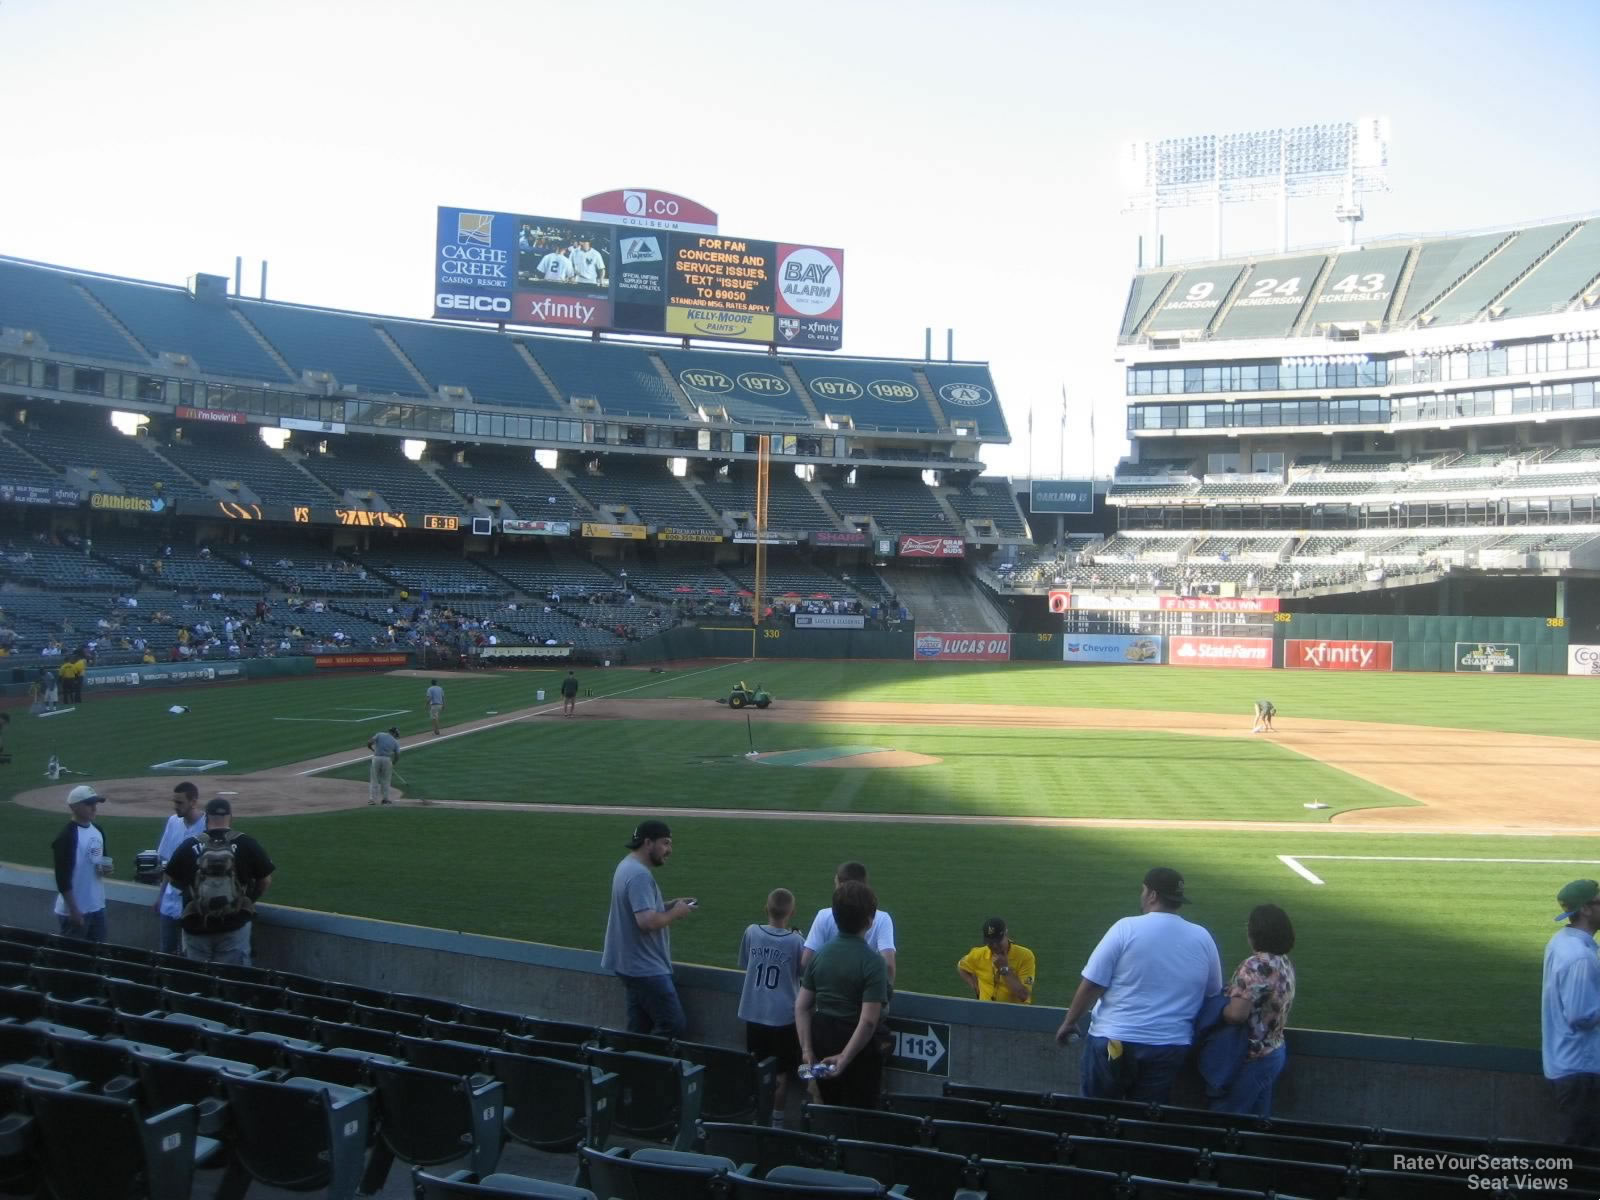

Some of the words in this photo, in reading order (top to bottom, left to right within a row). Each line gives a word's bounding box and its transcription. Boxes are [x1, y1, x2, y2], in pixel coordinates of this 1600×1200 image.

[622, 218, 679, 229] COLISEUM
[699, 238, 722, 250] FOR
[724, 241, 746, 252] FAN
[442, 245, 507, 263] CACHE
[679, 249, 740, 264] CONCERNS
[742, 256, 765, 267] AND
[442, 260, 507, 278] CREEK
[550, 261, 559, 273] 2
[676, 261, 723, 275] SERVICE
[725, 266, 768, 281] ISSUES,
[784, 261, 833, 285] BAY
[442, 275, 473, 285] CASINO
[477, 278, 507, 287] RESORT
[684, 273, 714, 286] TEXT
[1332, 273, 1385, 293] 43
[697, 287, 712, 298] TO
[715, 289, 746, 301] 69050
[783, 283, 832, 299] ALARM
[1186, 282, 1214, 300] 9
[1249, 277, 1300, 298] 24
[436, 293, 511, 313] GEICO
[1163, 299, 1220, 310] JACKSON
[1234, 295, 1304, 307] HENDERSON
[1318, 291, 1390, 304] ECKERSLEY
[530, 299, 596, 324] xfinity
[671, 297, 707, 306] STANDARD
[707, 299, 725, 308] MSG.
[725, 301, 748, 311] RATES
[748, 304, 770, 313] APPLY
[687, 309, 755, 324] KELLY-MOORE
[706, 322, 735, 332] PAINTS
[780, 319, 798, 327] MLB
[807, 322, 839, 335] xfinity
[686, 373, 729, 388] 1972
[743, 376, 785, 391] 1973
[815, 382, 857, 396] 1974
[874, 384, 913, 398] 1989
[198, 411, 210, 420] i'm
[211, 412, 231, 421] lovin'
[55, 490, 78, 500] xfinity
[91, 493, 151, 511] @Athletics
[1036, 492, 1077, 501] OAKLAND
[294, 507, 309, 522] VS
[431, 518, 455, 528] 6:19
[816, 533, 864, 541] SHARP
[1215, 601, 1235, 609] YOU
[1274, 613, 1291, 622] 362
[1546, 617, 1565, 627] 388
[763, 630, 780, 638] 330
[943, 640, 985, 653] LUCAS
[987, 640, 1008, 653] OIL
[1082, 643, 1120, 653] Chevron
[1304, 644, 1373, 667] xfinity
[1461, 657, 1515, 666] CHAMPIONS
[756, 963, 780, 989] 10
[906, 1037, 937, 1056] 113
